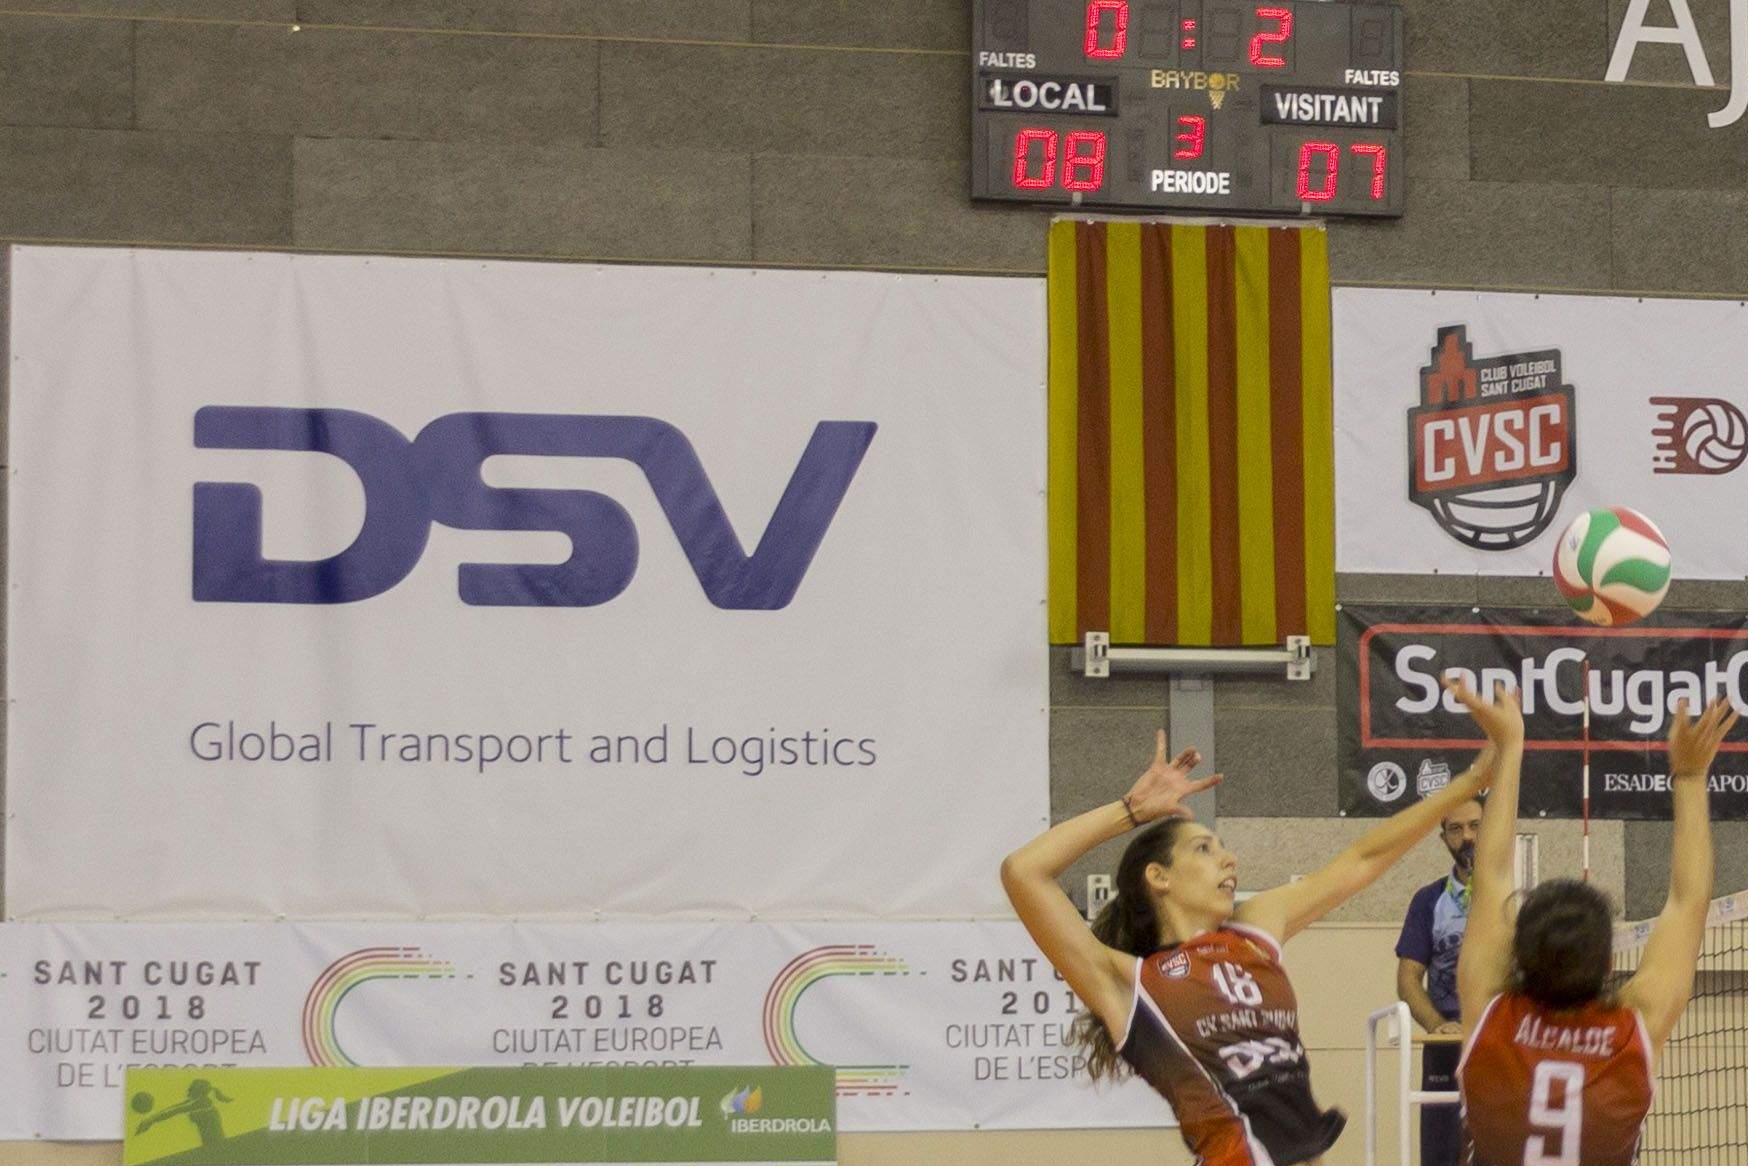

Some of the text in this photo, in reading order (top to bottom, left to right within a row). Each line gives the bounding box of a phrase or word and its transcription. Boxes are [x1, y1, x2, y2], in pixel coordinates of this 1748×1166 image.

[1085, 0, 1129, 59] 0
[1250, 7, 1293, 67] 2
[979, 51, 1036, 70] FALTES
[1344, 69, 1400, 87] FALTES
[994, 79, 1107, 113] LOCAL
[1275, 92, 1384, 125] VISITANT
[1174, 114, 1206, 161] 3
[1013, 127, 1107, 193] 08
[1297, 141, 1387, 202] 07
[1150, 169, 1231, 195] PERIODE
[1480, 360, 1556, 382] CLUB VOLEIBOL
[1480, 374, 1547, 397] SANT CUGAT
[1424, 403, 1561, 482] CVSC
[192, 405, 879, 611] DSV
[189, 721, 878, 777] Global Transport and Logistics
[34, 960, 262, 986] SANT CUGAT
[498, 959, 717, 987] SANT CUGAT
[951, 959, 1037, 982] SANT
[88, 995, 207, 1020] 2018
[550, 995, 664, 1021] 2018
[1002, 992, 1079, 1014] 201
[27, 1028, 268, 1055] CIUTAT EUROPEA
[492, 1025, 723, 1055] CIUTAT EUROPEA
[946, 1024, 1035, 1048] CIUTAT
[1513, 1013, 1617, 1058] ALCALDE
[57, 1064, 94, 1089] DE
[975, 1056, 1008, 1080] DE
[269, 1096, 703, 1131] LIGA IBERDROLA VOLEIBOL
[731, 1117, 831, 1133] IBERDROLA
